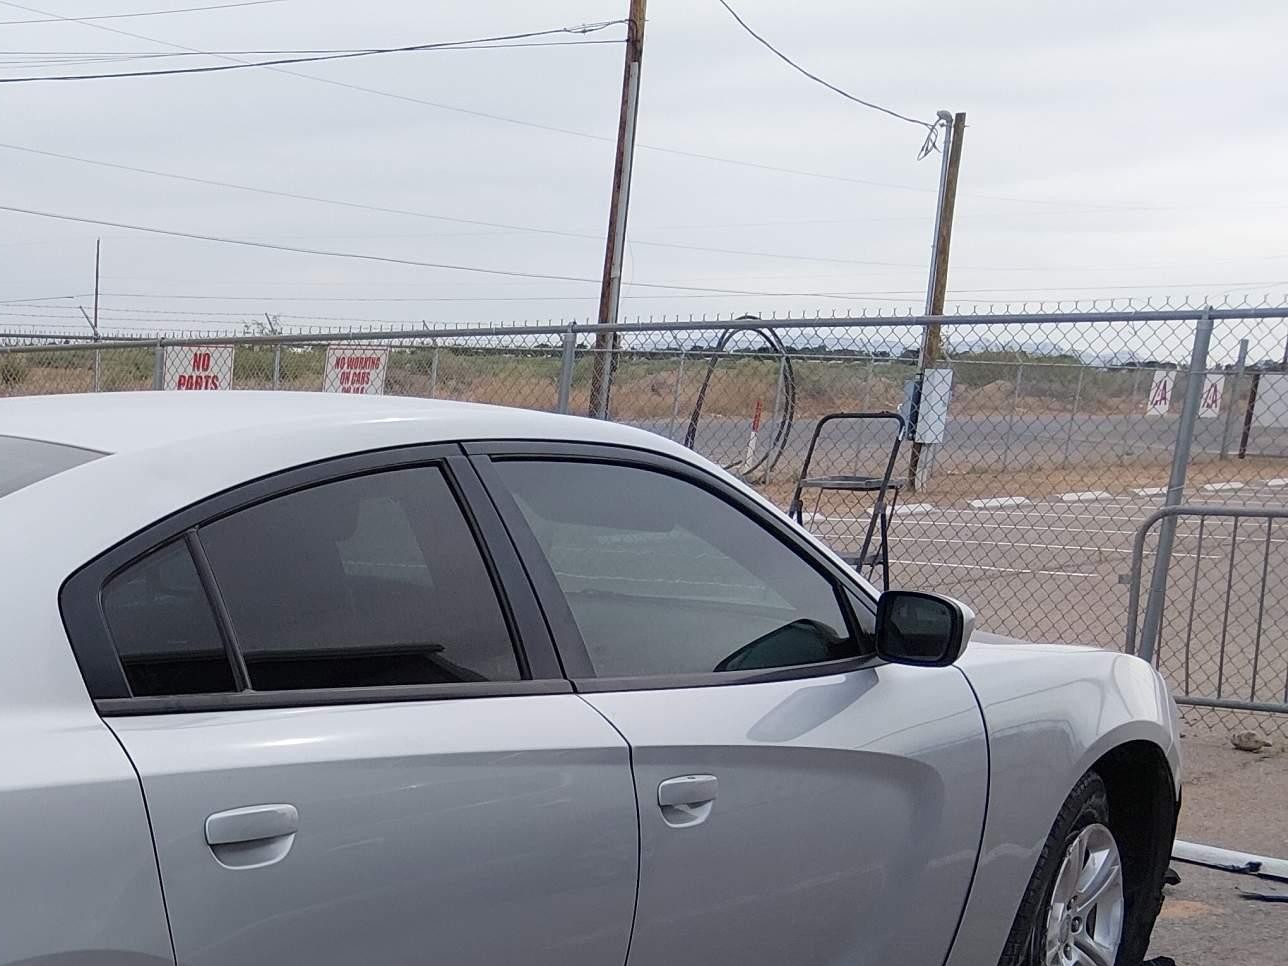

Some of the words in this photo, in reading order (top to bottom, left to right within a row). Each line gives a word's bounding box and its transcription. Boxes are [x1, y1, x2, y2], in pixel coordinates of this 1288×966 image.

[192, 352, 211, 372] NO
[334, 356, 346, 370] NO
[346, 356, 381, 370] WORKING
[177, 375, 219, 391] PARTS
[340, 372, 351, 385] ON
[352, 372, 370, 385] CARS
